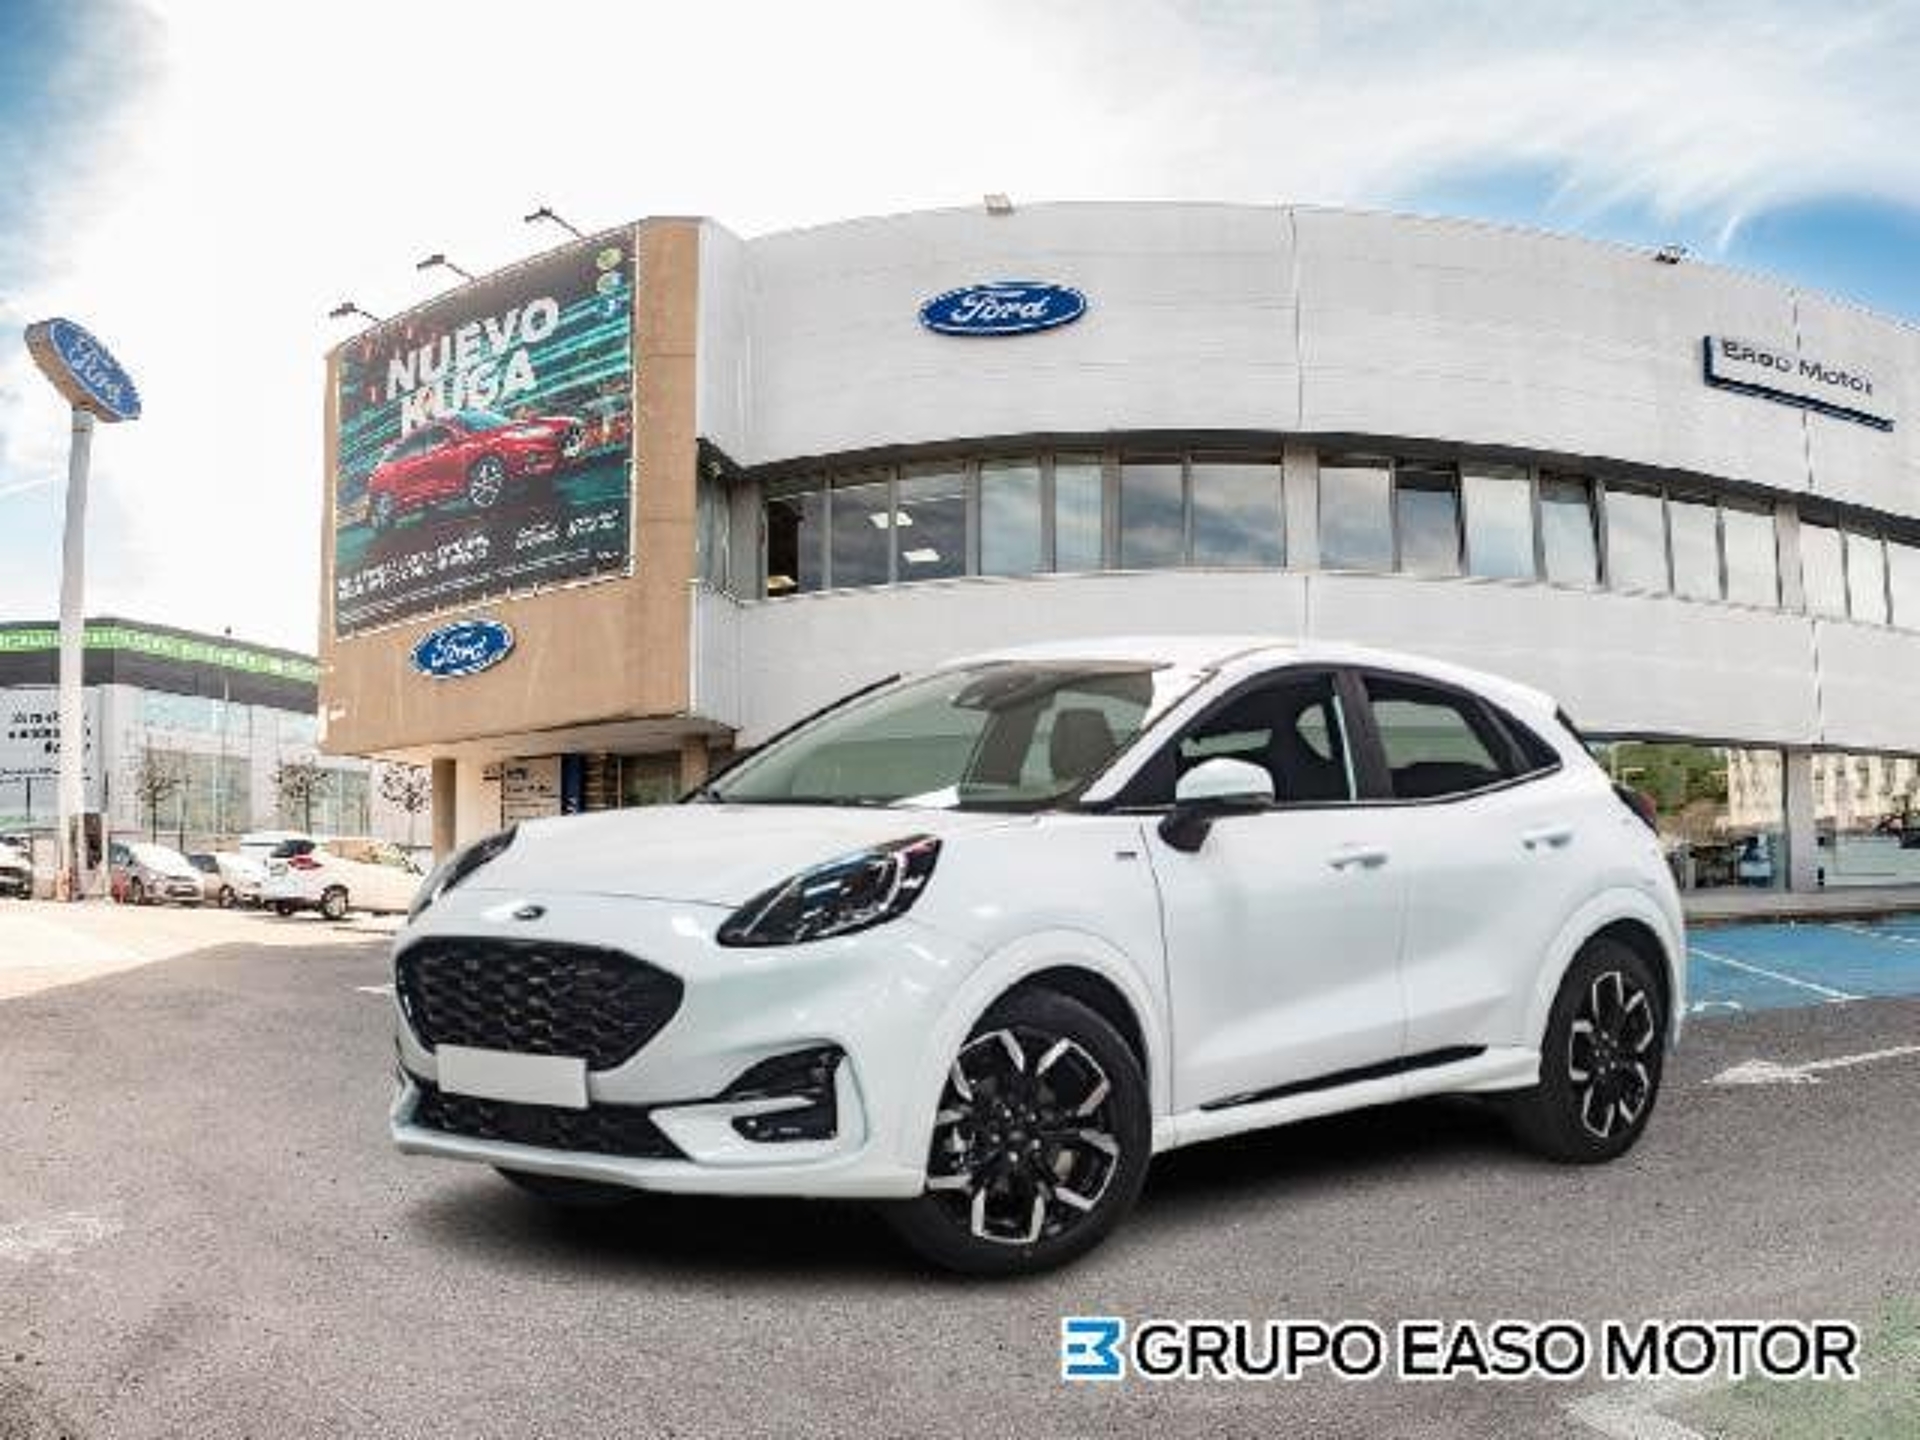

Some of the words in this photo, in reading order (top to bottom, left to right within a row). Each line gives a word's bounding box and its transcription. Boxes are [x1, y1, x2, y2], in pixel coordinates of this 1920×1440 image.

[951, 290, 1051, 323] Ford
[69, 337, 119, 400] Ford
[386, 296, 559, 401] NUEVO
[1721, 338, 1791, 373] Easo
[1799, 359, 1873, 397] Motor
[401, 347, 537, 441] KUGA
[430, 629, 489, 667] Ford
